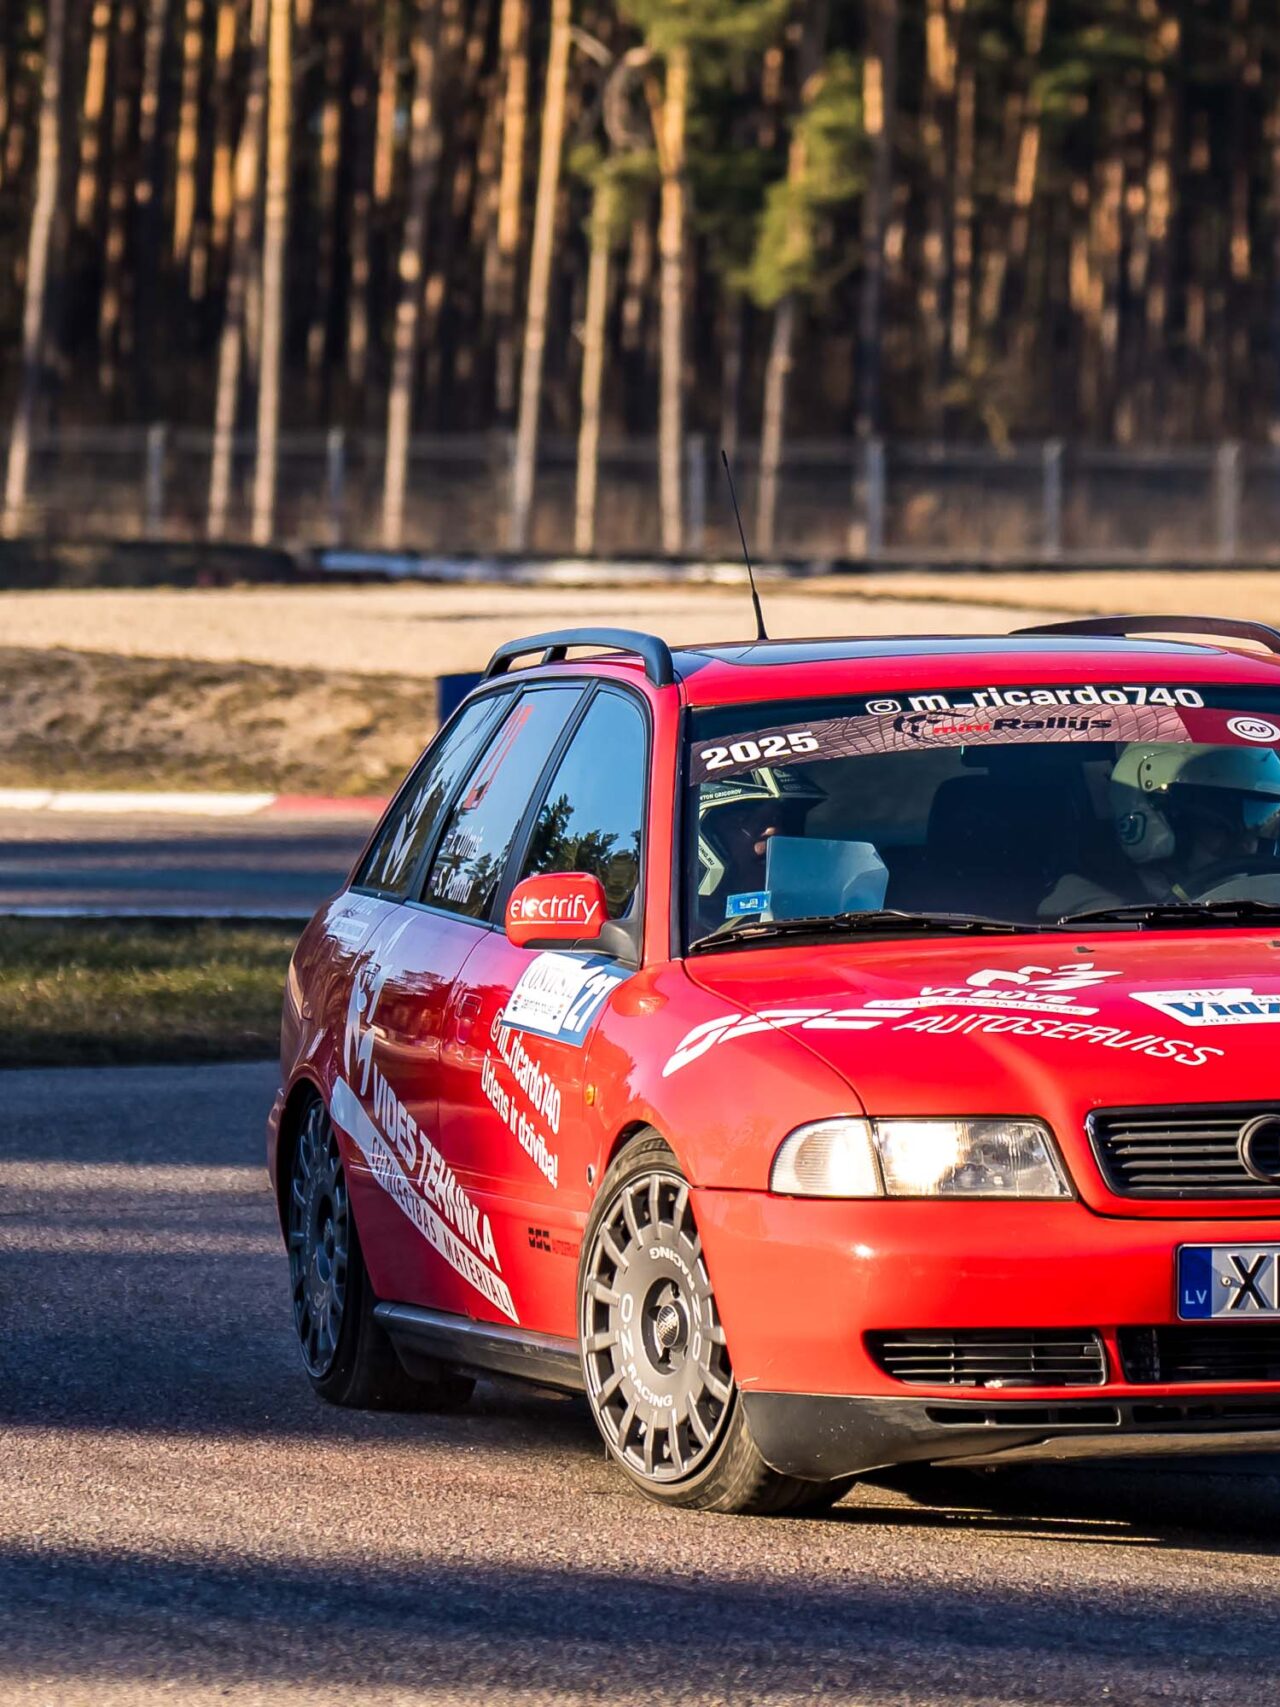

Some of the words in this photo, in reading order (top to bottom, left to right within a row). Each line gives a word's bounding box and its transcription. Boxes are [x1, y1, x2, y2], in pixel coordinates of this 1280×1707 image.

[908, 685, 1205, 712] m_ricardo740
[700, 731, 820, 771] 2025
[510, 894, 600, 925] electrify
[919, 986, 973, 997] VT
[892, 1012, 1224, 1067] AUTOSERVISS
[509, 1096, 519, 1136] ir
[373, 1062, 418, 1172] VIDES
[417, 1129, 502, 1273] TEHNIKA
[649, 1246, 696, 1292] RACING
[1184, 1289, 1208, 1305] LV
[627, 1362, 673, 1408] RACING
